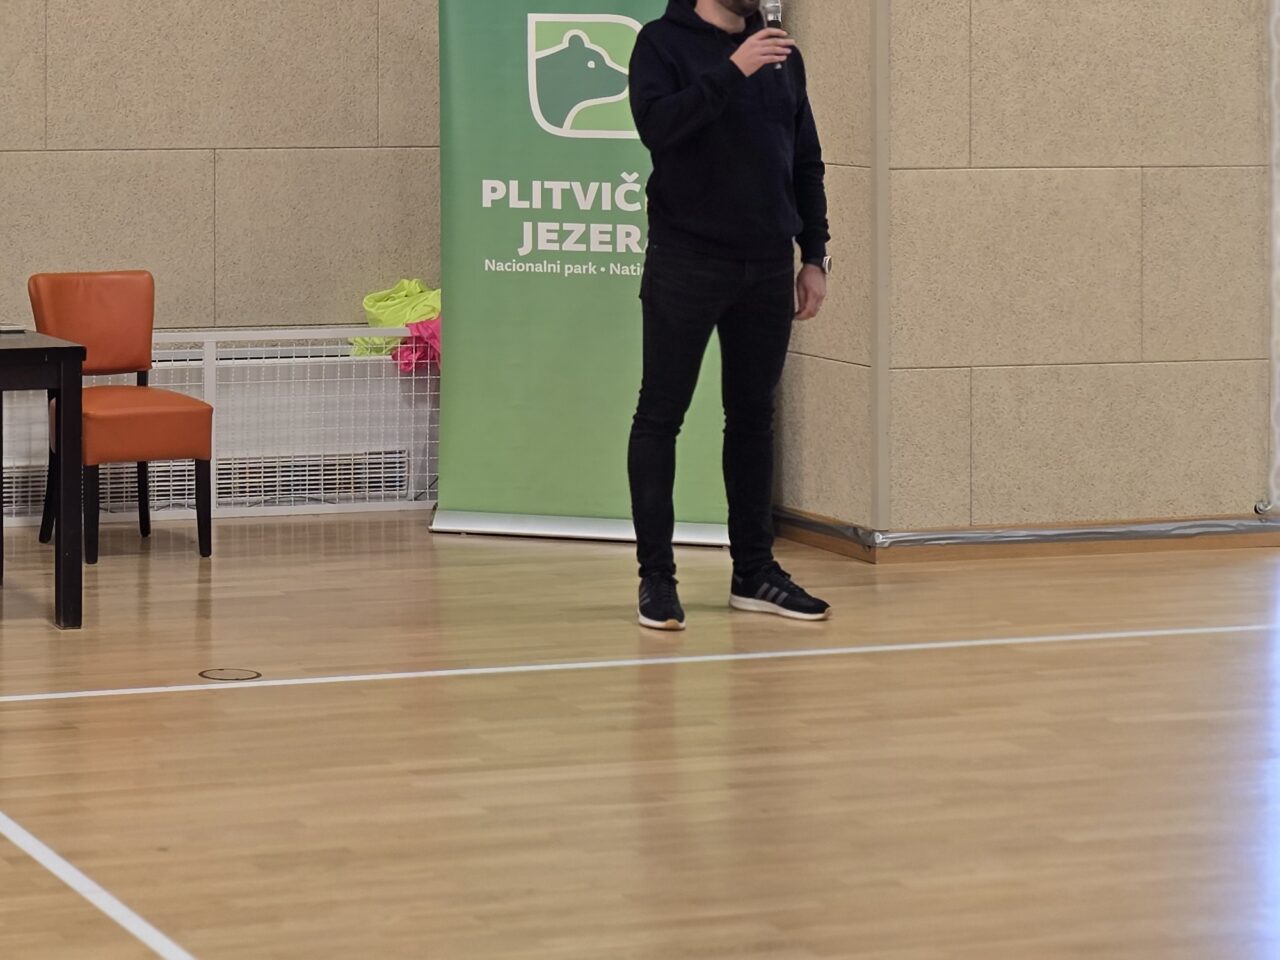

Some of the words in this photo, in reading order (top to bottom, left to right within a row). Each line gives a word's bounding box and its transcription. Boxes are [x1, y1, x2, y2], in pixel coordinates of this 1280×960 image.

[482, 171, 644, 212] PLITVIČ
[517, 221, 648, 256] JEZER
[484, 259, 561, 274] Nacionalni
[564, 262, 597, 277] park
